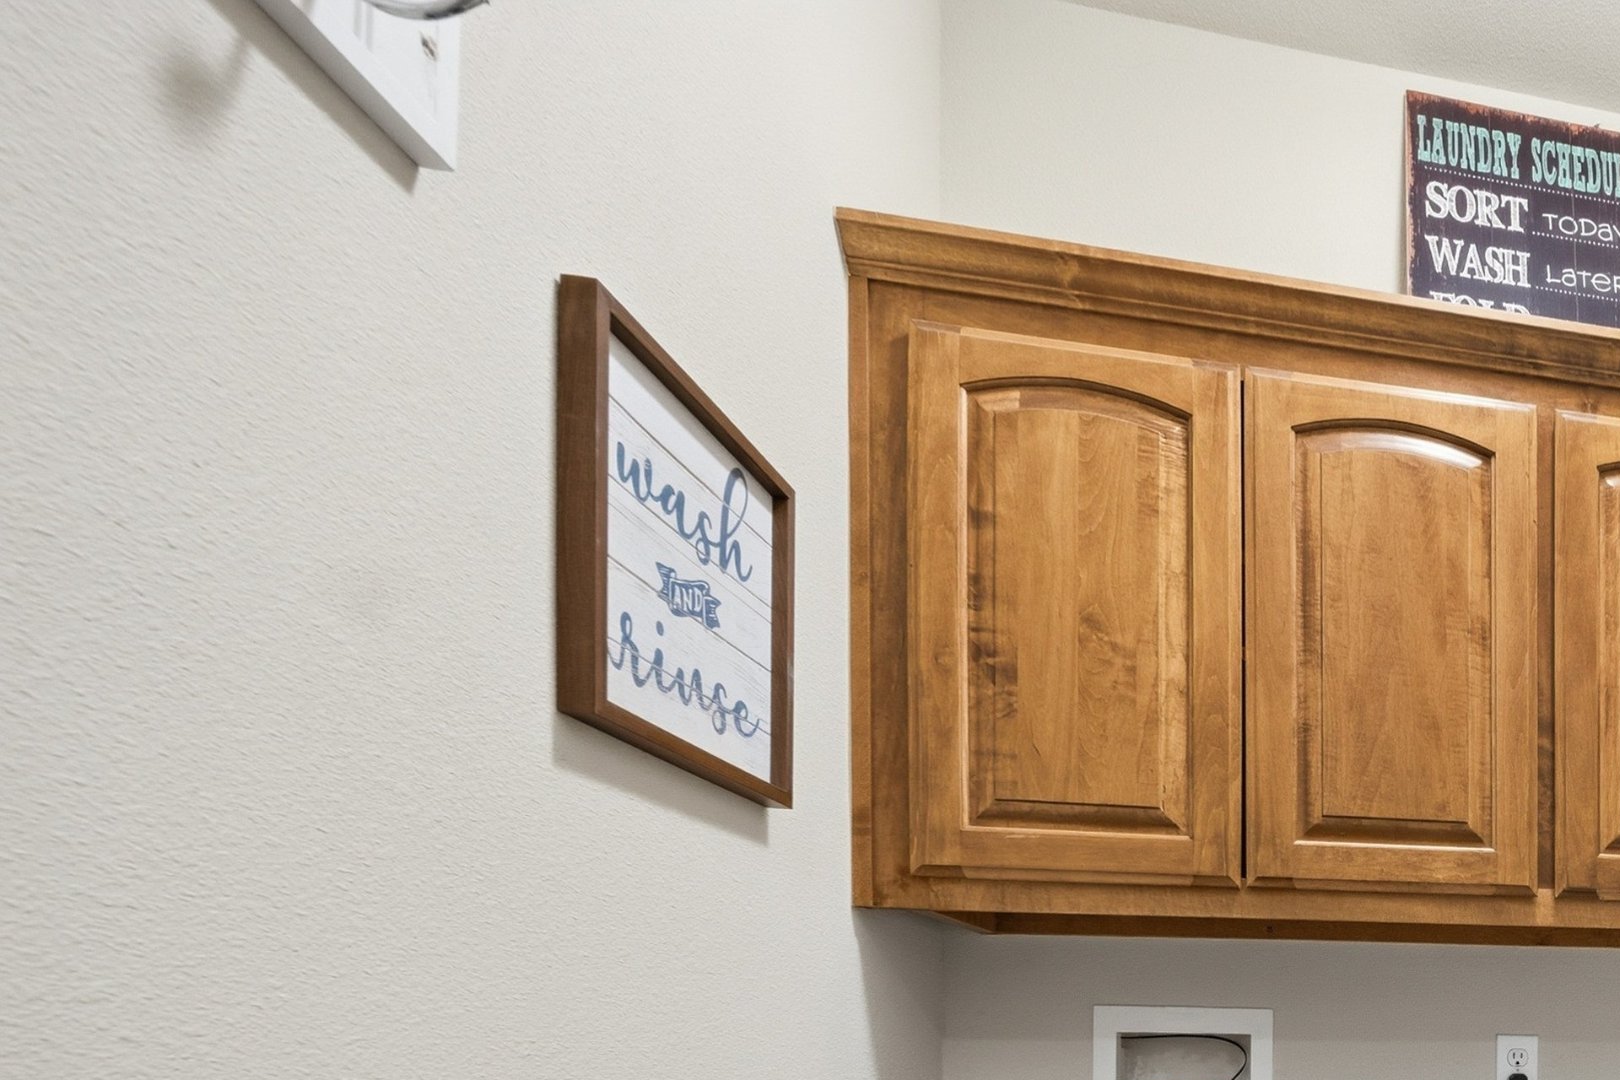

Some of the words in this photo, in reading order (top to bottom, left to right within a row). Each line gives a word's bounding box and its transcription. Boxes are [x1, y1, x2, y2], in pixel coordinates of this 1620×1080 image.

[1417, 114, 1522, 180] LAUNDRY
[1424, 180, 1529, 234] SORT
[1424, 234, 1532, 289] WASH
[615, 439, 754, 583] wash
[672, 585, 704, 616] AND
[607, 611, 761, 739] rinse
